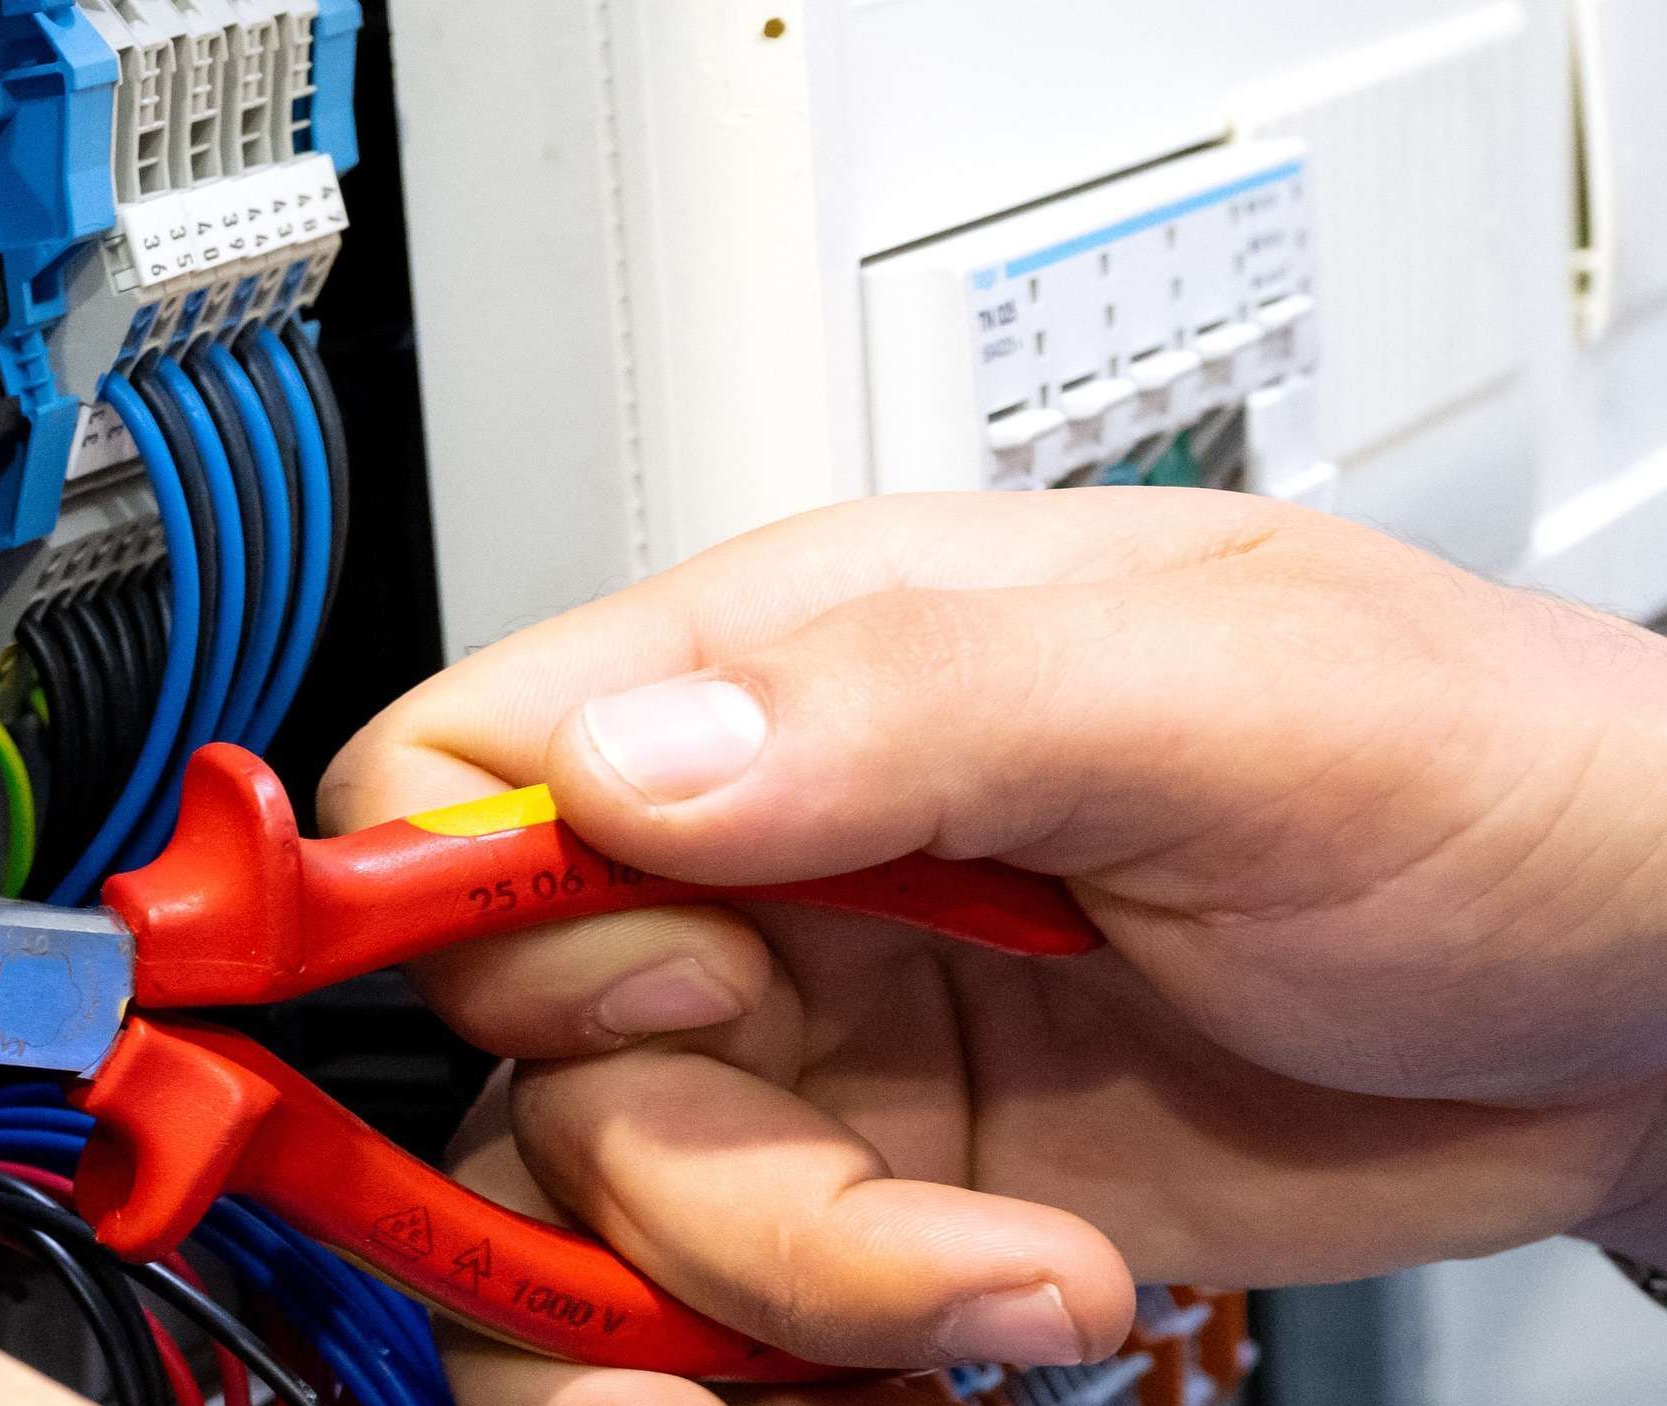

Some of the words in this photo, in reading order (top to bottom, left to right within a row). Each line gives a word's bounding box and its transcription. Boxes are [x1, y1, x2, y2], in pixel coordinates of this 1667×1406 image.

[272, 200, 293, 238] 43
[321, 186, 343, 224] 47
[169, 225, 194, 268] 35
[196, 221, 220, 262] 40
[222, 212, 246, 251] 39
[247, 207, 269, 248] 44
[143, 234, 167, 277] 36
[468, 878, 518, 912] 25
[531, 866, 584, 901] 06
[511, 1280, 594, 1327] 1000
[603, 1306, 626, 1335] V
